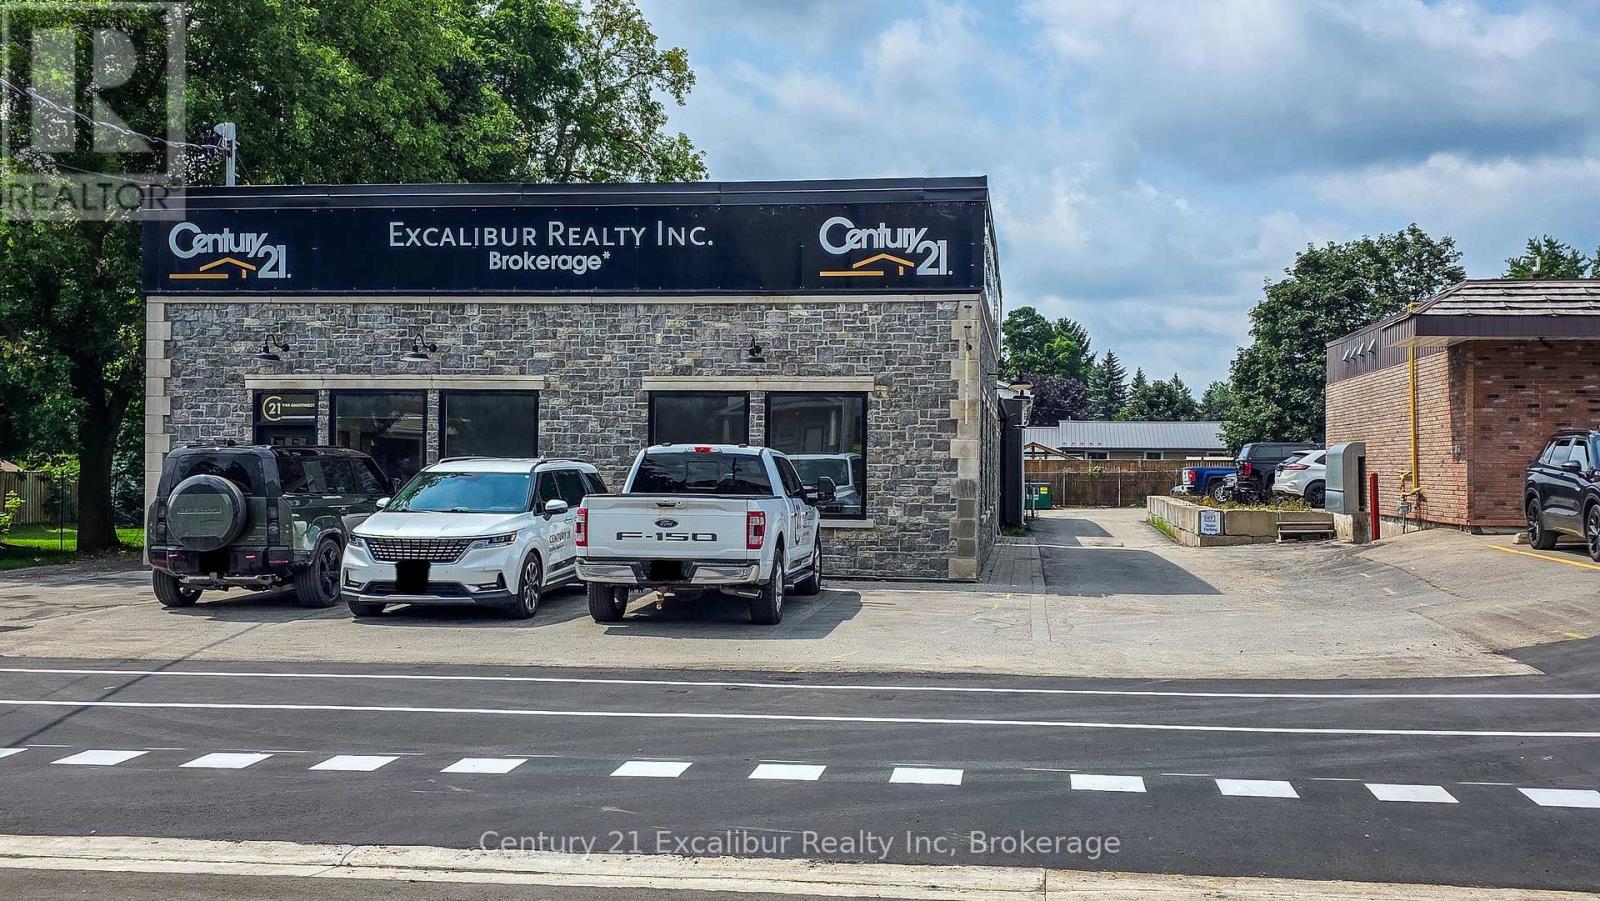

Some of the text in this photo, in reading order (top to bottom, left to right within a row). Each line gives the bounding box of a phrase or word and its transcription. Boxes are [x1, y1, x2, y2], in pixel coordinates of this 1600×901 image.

[168, 221, 268, 259] Century
[389, 221, 537, 247] EXCALIBUR
[548, 221, 646, 247] REALTY
[819, 216, 928, 255] Century
[616, 531, 718, 542] F-150
